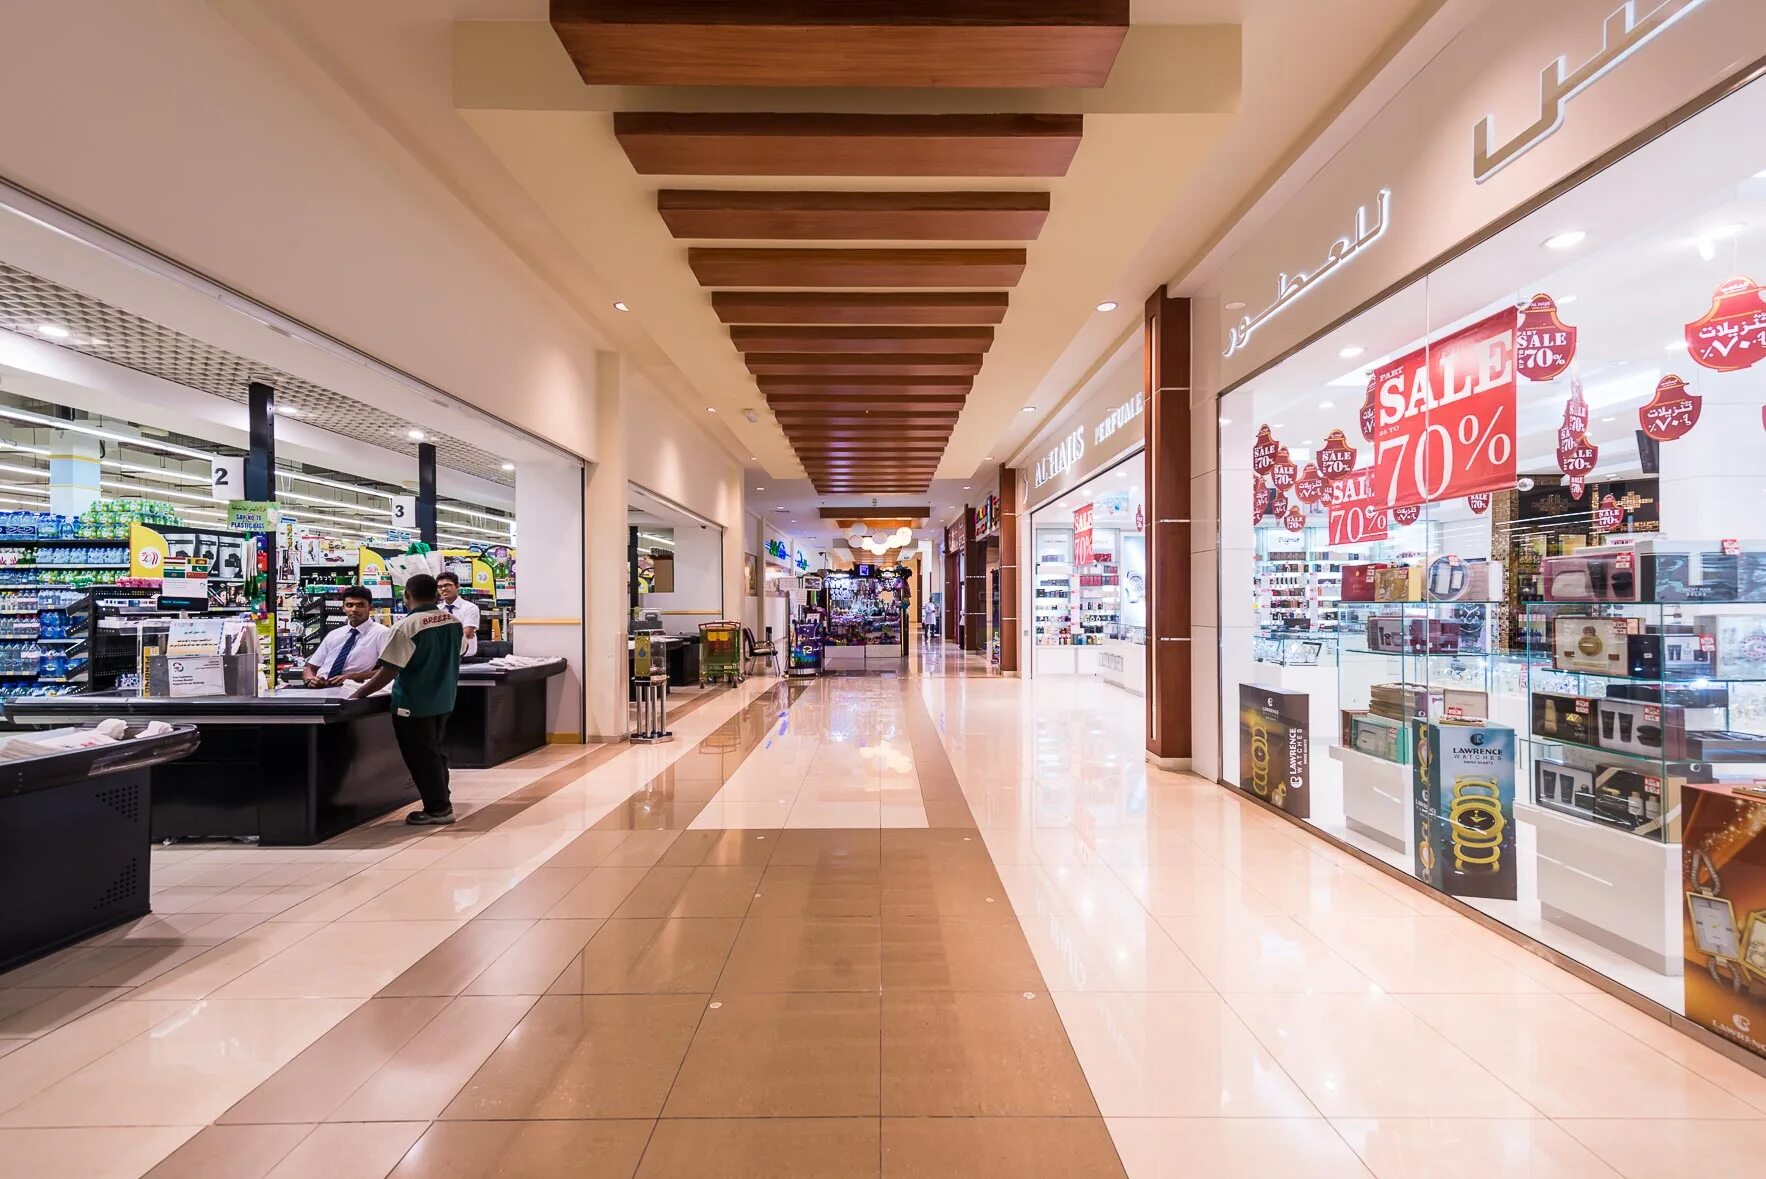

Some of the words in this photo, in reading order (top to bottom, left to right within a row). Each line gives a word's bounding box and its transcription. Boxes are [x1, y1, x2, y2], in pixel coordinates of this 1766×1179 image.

[1222, 188, 1391, 358] للعطور
[1517, 333, 1567, 348] SALE
[1525, 348, 1566, 369] 70%
[1379, 329, 1513, 428] SALE
[1380, 366, 1404, 382] PART
[1255, 445, 1276, 457] SALE
[1322, 452, 1351, 461] SALE
[1377, 405, 1511, 507] 70%
[1573, 449, 1593, 458] ALE
[1257, 456, 1275, 468] 70%
[1327, 461, 1350, 473] 70%
[1568, 458, 1591, 470] 70%
[1274, 466, 1294, 474] SALE
[215, 468, 228, 485] 2
[1277, 474, 1294, 485] 70%
[395, 505, 404, 518] 3
[1074, 511, 1093, 532] SALE
[422, 614, 452, 626] BREEZE
[1289, 728, 1297, 775] LAWRENCE
[1453, 747, 1503, 755] LAWRENCE
